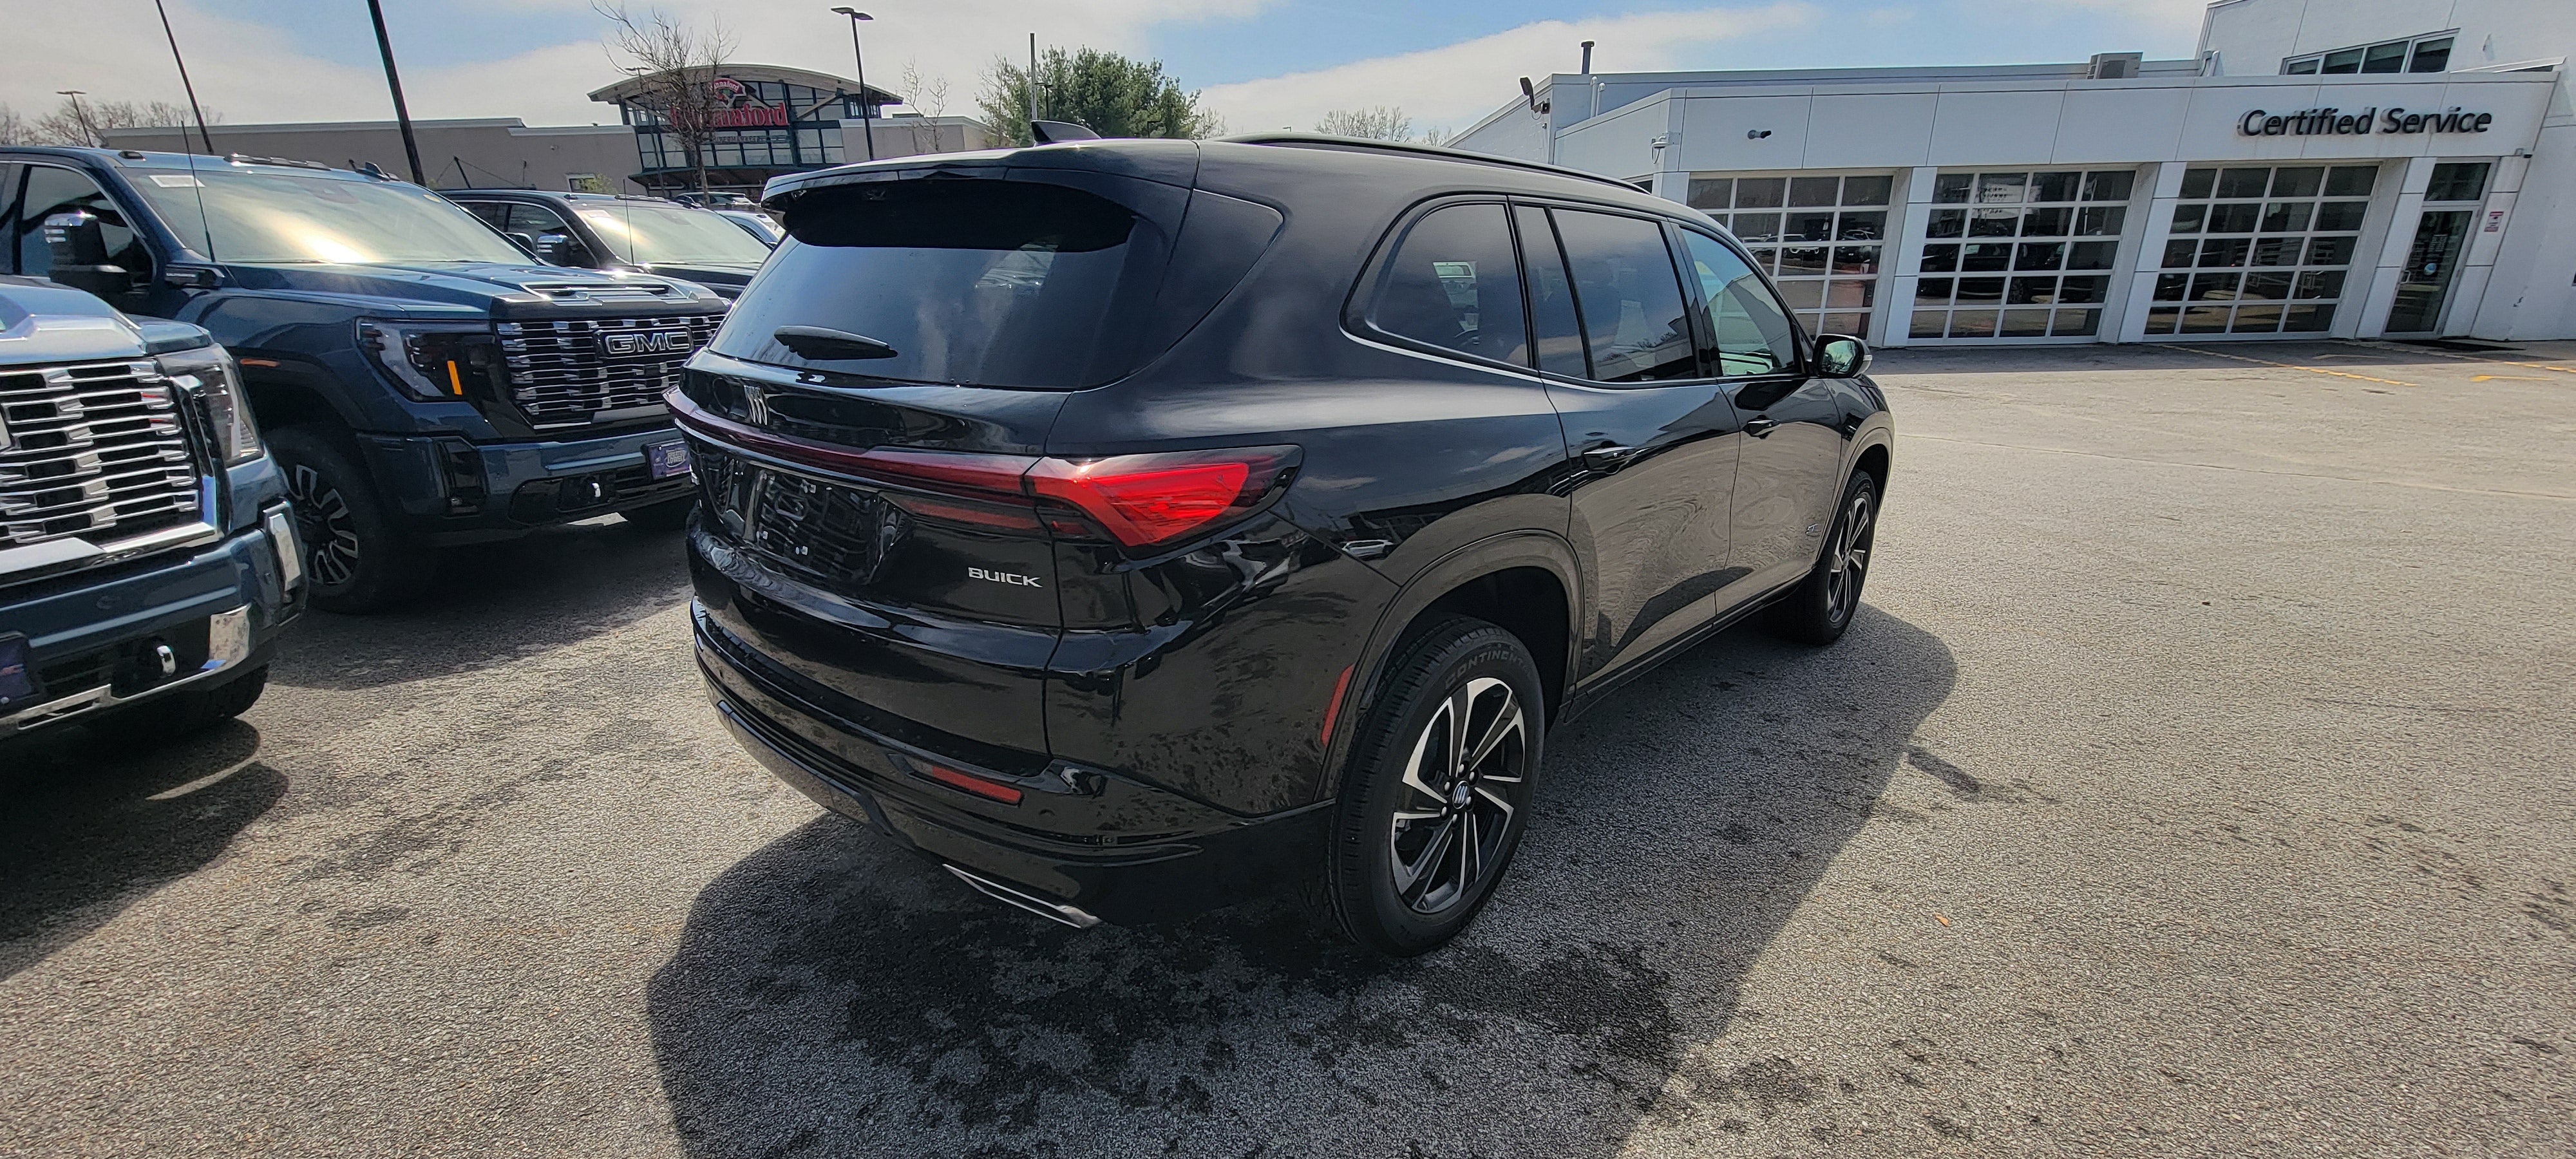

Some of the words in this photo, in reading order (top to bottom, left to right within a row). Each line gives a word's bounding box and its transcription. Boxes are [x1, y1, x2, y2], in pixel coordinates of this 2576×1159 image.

[710, 81, 740, 91] nnaford
[670, 102, 789, 129] naford
[2244, 108, 2377, 137] Certified
[2383, 107, 2492, 134] Service
[605, 332, 690, 353] GMC
[968, 567, 1043, 588] BUICK
